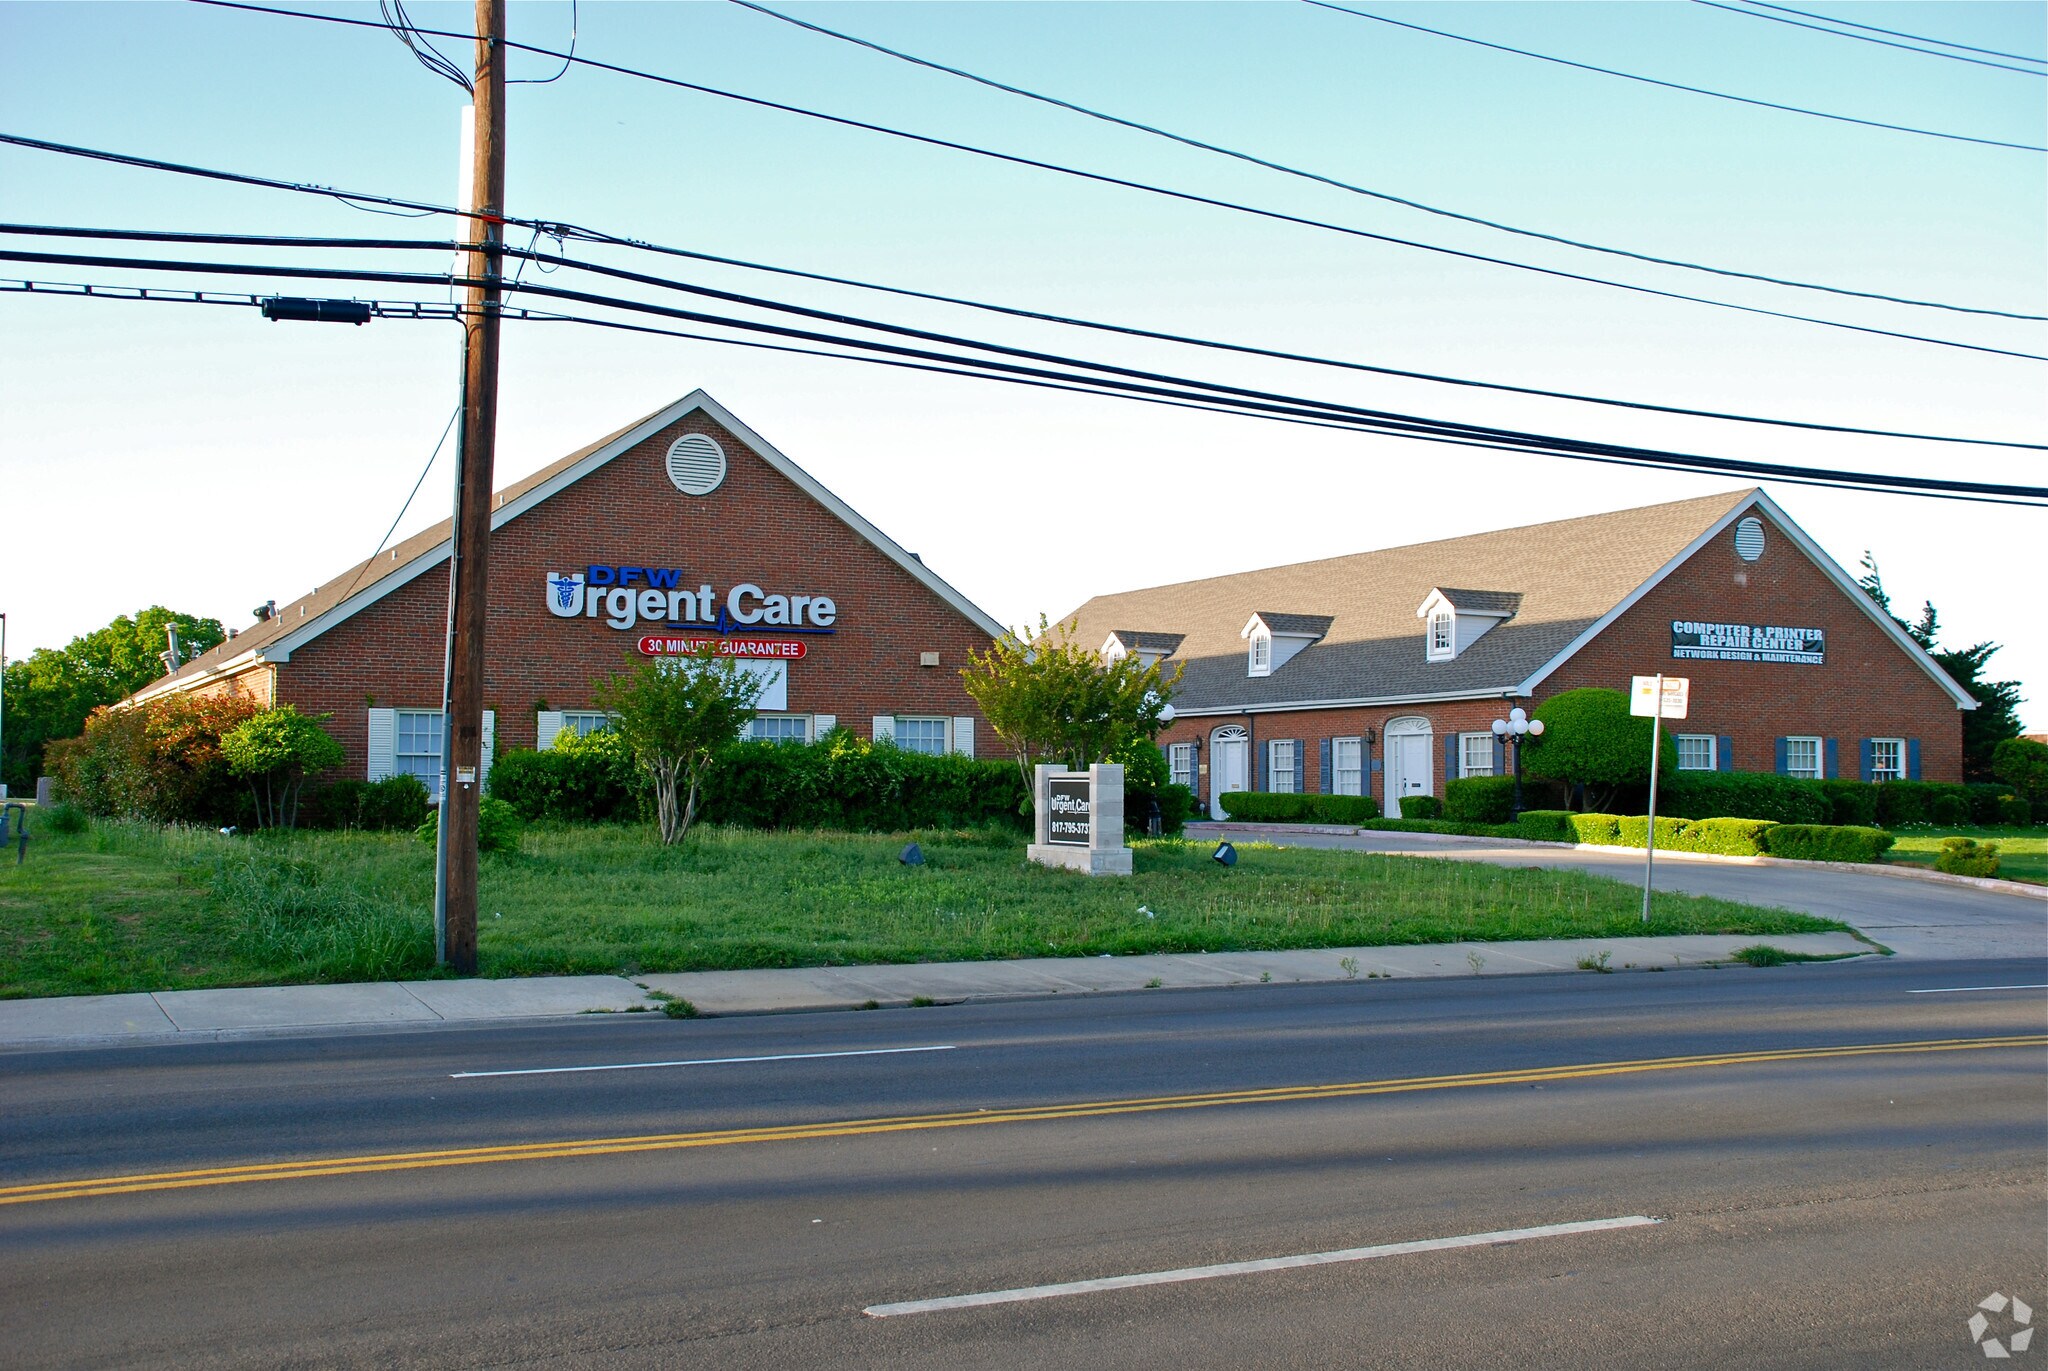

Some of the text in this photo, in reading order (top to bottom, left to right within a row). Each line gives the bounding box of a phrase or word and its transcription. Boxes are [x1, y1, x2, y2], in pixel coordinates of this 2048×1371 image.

[587, 565, 683, 589] DFW
[546, 571, 837, 630] Urgent Care
[1673, 621, 1823, 641] COMPUTER & PRINTER
[648, 639, 799, 656] 30 MINUT GUARANTEE
[1700, 634, 1804, 651] REPAIR CENTER
[1673, 649, 1824, 665] NETWORK DESIGN & MAINTENANCE
[1051, 797, 1075, 814] Urgent
